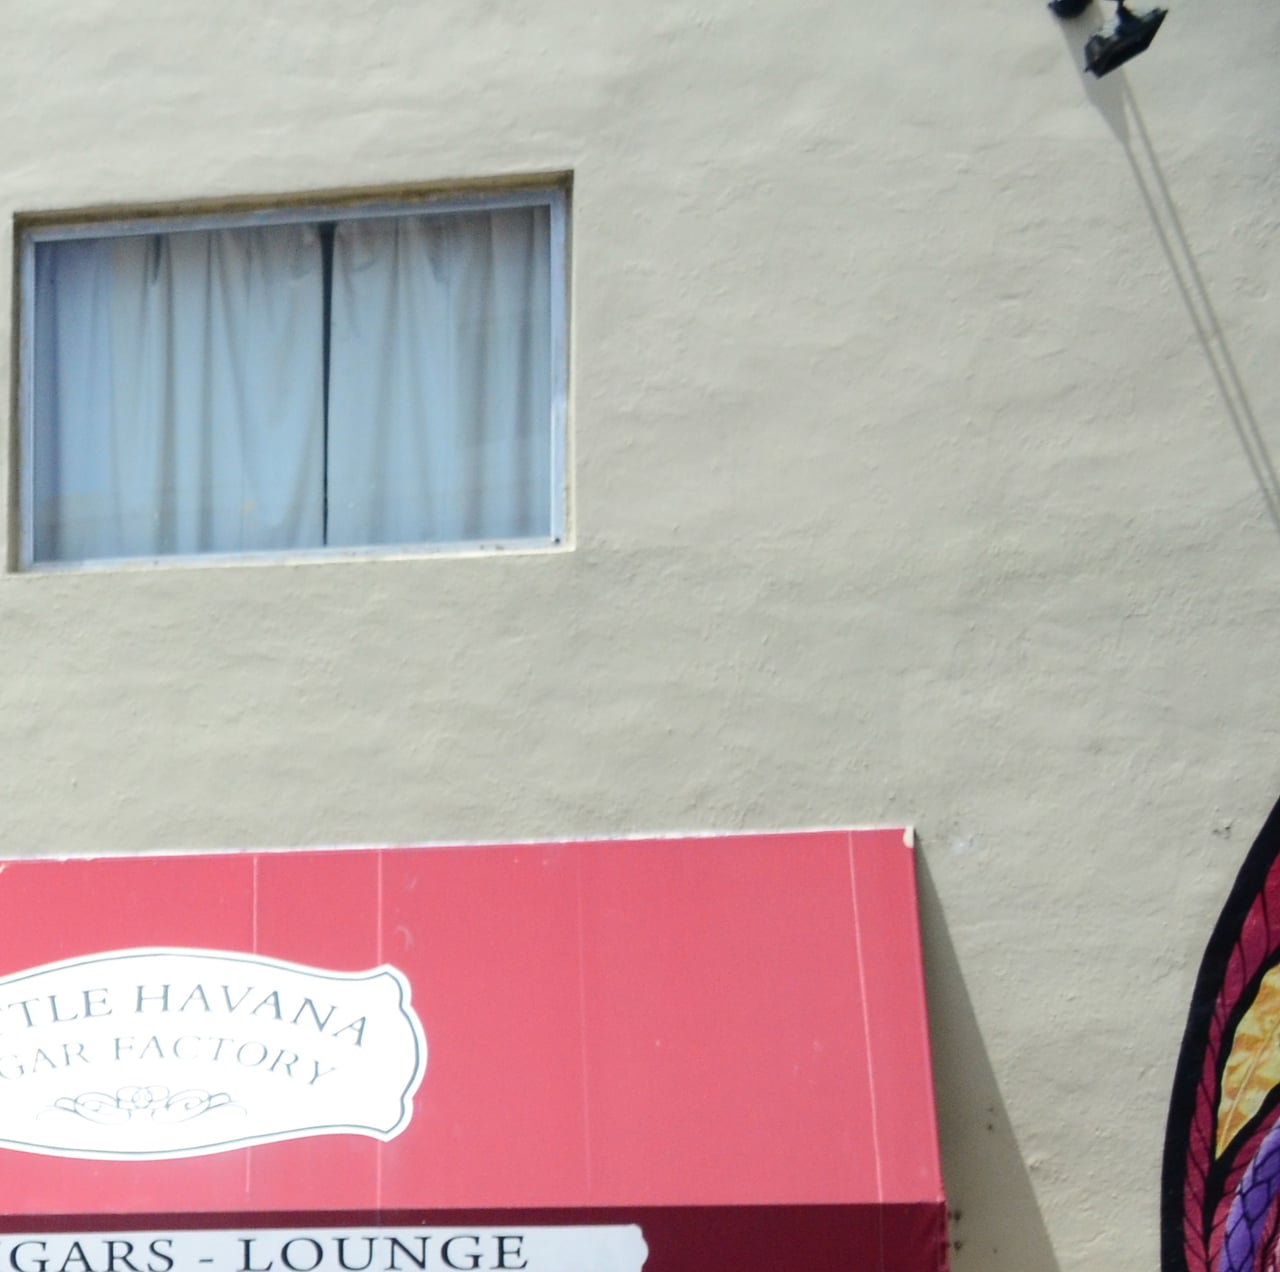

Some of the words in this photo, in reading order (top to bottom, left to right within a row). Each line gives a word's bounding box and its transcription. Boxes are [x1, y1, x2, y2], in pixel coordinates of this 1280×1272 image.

[134, 984, 368, 1047] HAVANA
[114, 1035, 336, 1087] FACTORY
[236, 1234, 529, 1272] LOUNGE
